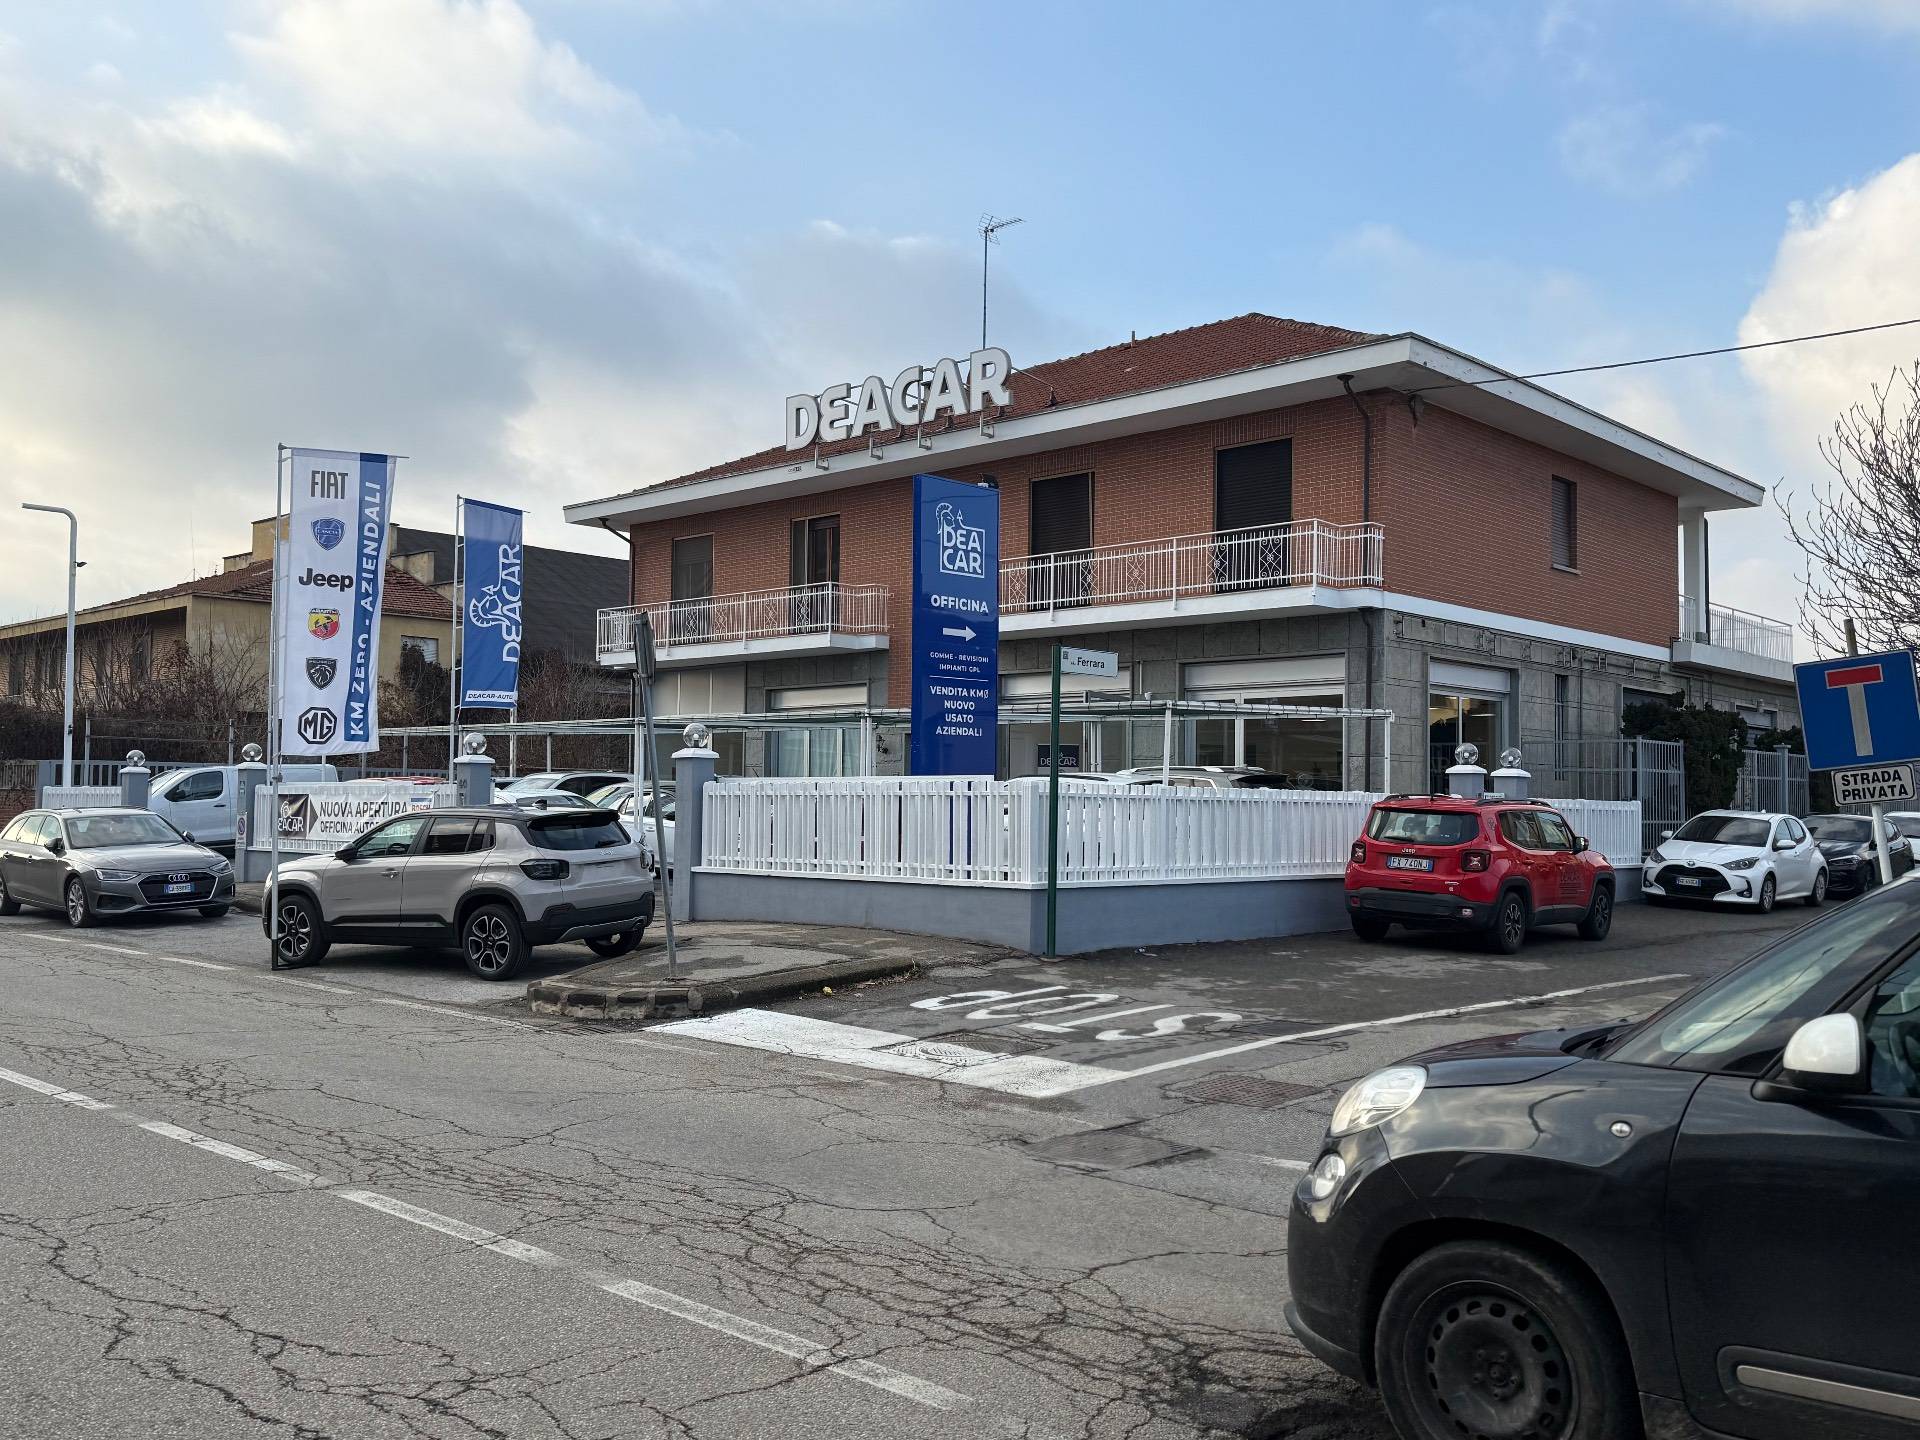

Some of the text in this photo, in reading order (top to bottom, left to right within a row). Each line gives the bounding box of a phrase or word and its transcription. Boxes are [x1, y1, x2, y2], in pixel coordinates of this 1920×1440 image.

[786, 347, 1013, 451] DEACAR
[310, 470, 348, 499] FIAT
[943, 528, 981, 551] DEA
[943, 549, 982, 574] CAR
[298, 568, 353, 592] Jeep
[350, 701, 365, 735] KM
[361, 482, 381, 612] AZIENDALI
[499, 544, 521, 662] DEACAR
[930, 594, 989, 613] OFFICINA
[930, 651, 954, 660] GOMME
[958, 654, 989, 663] REVISIONI
[1077, 656, 1105, 669] Ferrara
[939, 664, 967, 672] IMPIANTI
[930, 685, 968, 697] VENDITA
[944, 700, 975, 710] NUOVO
[302, 711, 334, 736] MG
[945, 713, 974, 723] USATO
[935, 726, 982, 737] AZIENDALI
[1040, 757, 1077, 766] DECAR
[1841, 769, 1902, 787] STRADA
[1841, 784, 1909, 801] PRIVATA
[319, 801, 408, 818] NUOVA APERTURA
[276, 816, 304, 832] EACAR
[320, 821, 353, 834] OFFICINA
[910, 985, 1243, 1042] STOP
